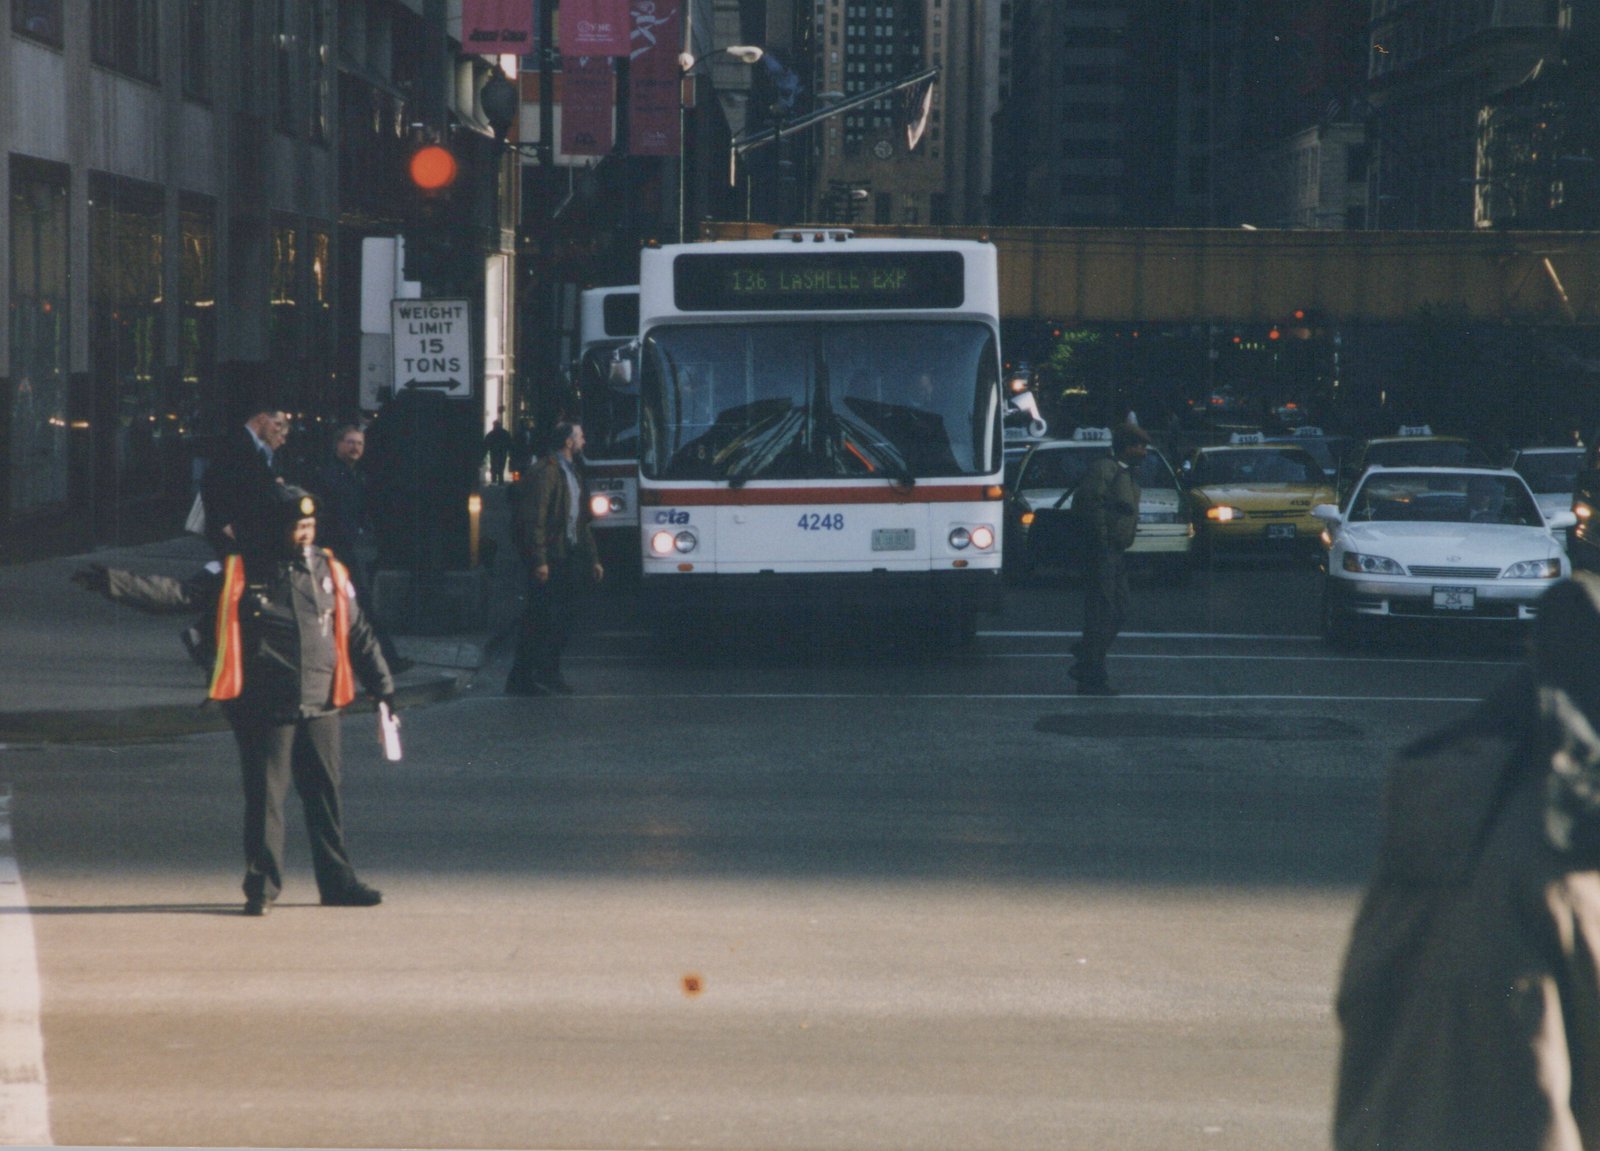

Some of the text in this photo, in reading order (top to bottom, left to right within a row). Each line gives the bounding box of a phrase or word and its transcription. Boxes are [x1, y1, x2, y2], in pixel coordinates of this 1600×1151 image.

[732, 269, 767, 290] 136
[872, 267, 907, 290] EXP
[399, 306, 462, 319] WEIGHT
[409, 322, 453, 335] LIMIT
[419, 338, 444, 354] 15
[404, 357, 461, 373] TONS
[655, 508, 690, 525] cta
[797, 513, 845, 531] 4248
